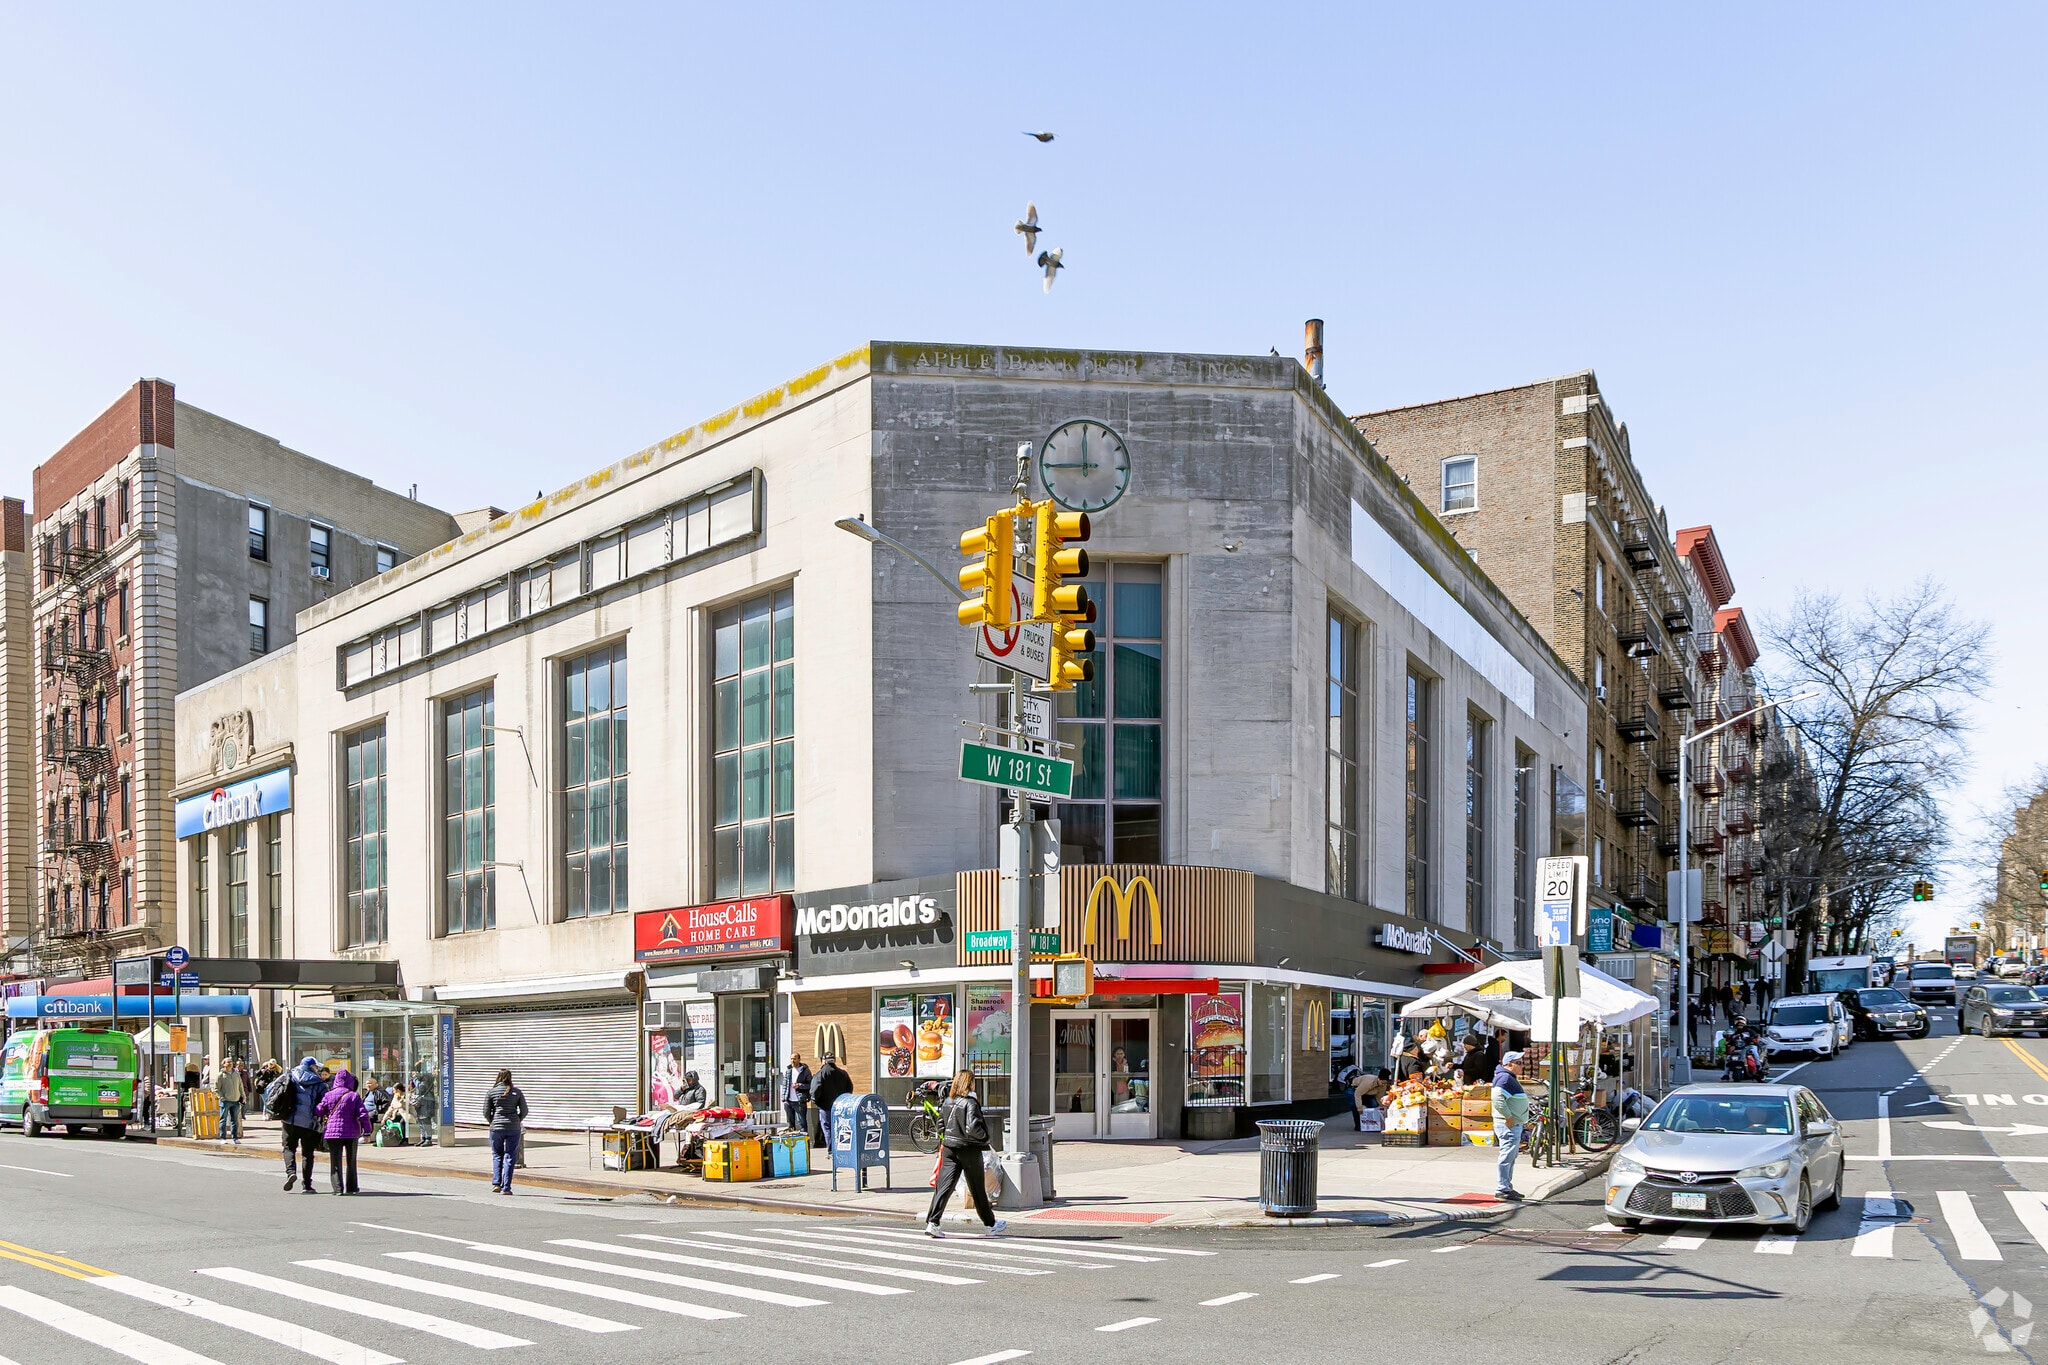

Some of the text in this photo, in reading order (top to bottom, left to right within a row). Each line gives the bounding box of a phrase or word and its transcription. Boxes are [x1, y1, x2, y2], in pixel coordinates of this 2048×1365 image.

[1007, 354, 1074, 372] BANK
[1023, 628, 1045, 647] TRUCKS
[1020, 644, 1045, 663] & BUSES
[987, 753, 1052, 787] W 181 St
[202, 782, 263, 830] citibank
[1547, 862, 1571, 870] SPEED
[1547, 880, 1569, 896] 20
[688, 902, 758, 929] HouseCalls
[795, 895, 938, 936] McDonald's
[690, 925, 756, 943] HOME CARE
[971, 934, 1008, 950] Broadway
[1030, 934, 1057, 950] W 181 St
[1386, 923, 1432, 955] McDonald's
[44, 1000, 102, 1013] citibank
[921, 1003, 928, 1017] 2
[442, 1023, 450, 1054] Broadway
